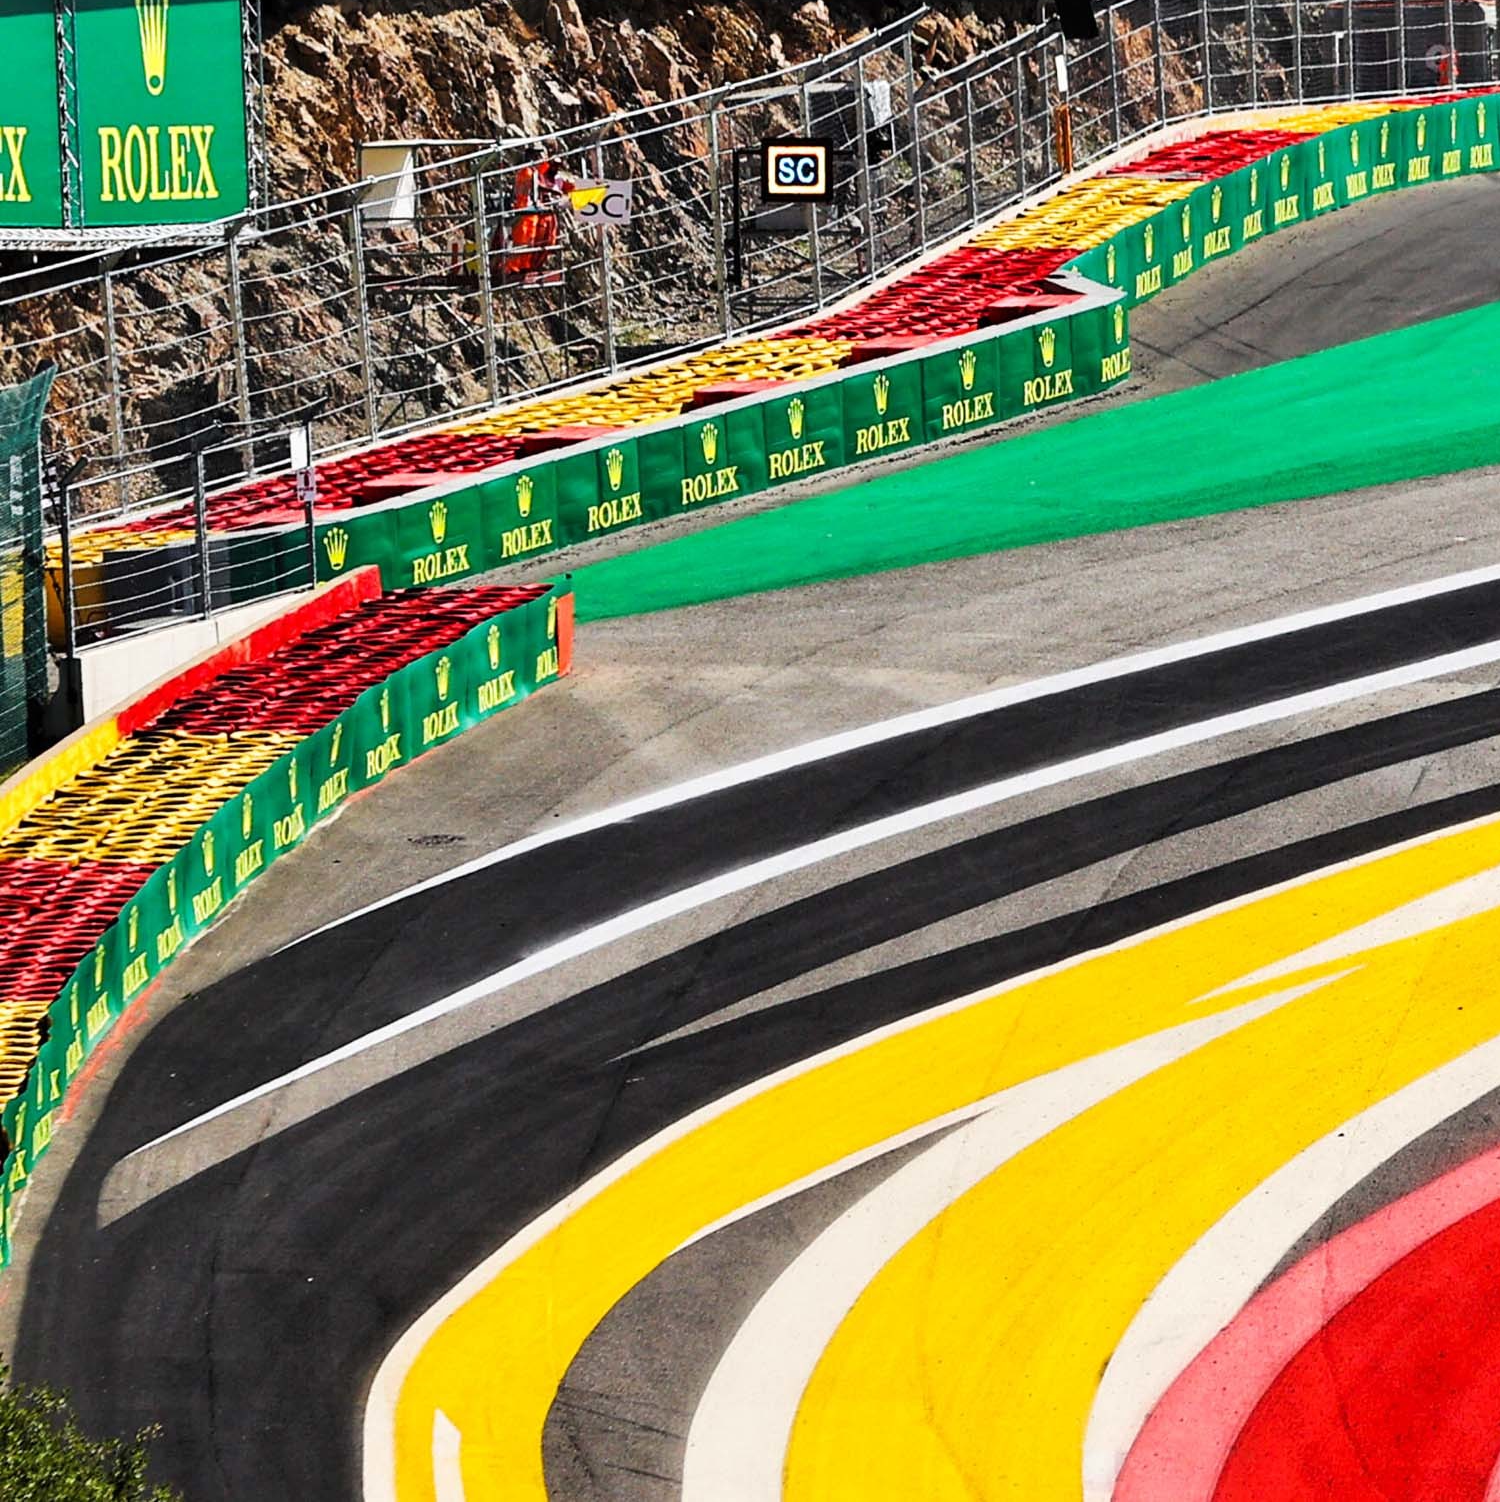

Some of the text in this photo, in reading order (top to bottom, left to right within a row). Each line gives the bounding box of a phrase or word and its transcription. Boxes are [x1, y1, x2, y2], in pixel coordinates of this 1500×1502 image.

[98, 124, 219, 203] ROLEX
[778, 157, 815, 184] SC
[1101, 347, 1131, 383] ROLE
[1024, 369, 1073, 406] ROLEX
[943, 392, 994, 430] ROLEX
[856, 417, 910, 454] ROLEX
[769, 441, 825, 480] ROLEX
[682, 466, 739, 505] ROLEX
[588, 492, 643, 532] ROLEX
[501, 519, 553, 559] ROLEX
[413, 544, 471, 586] ROLEX
[536, 646, 558, 683] ROL
